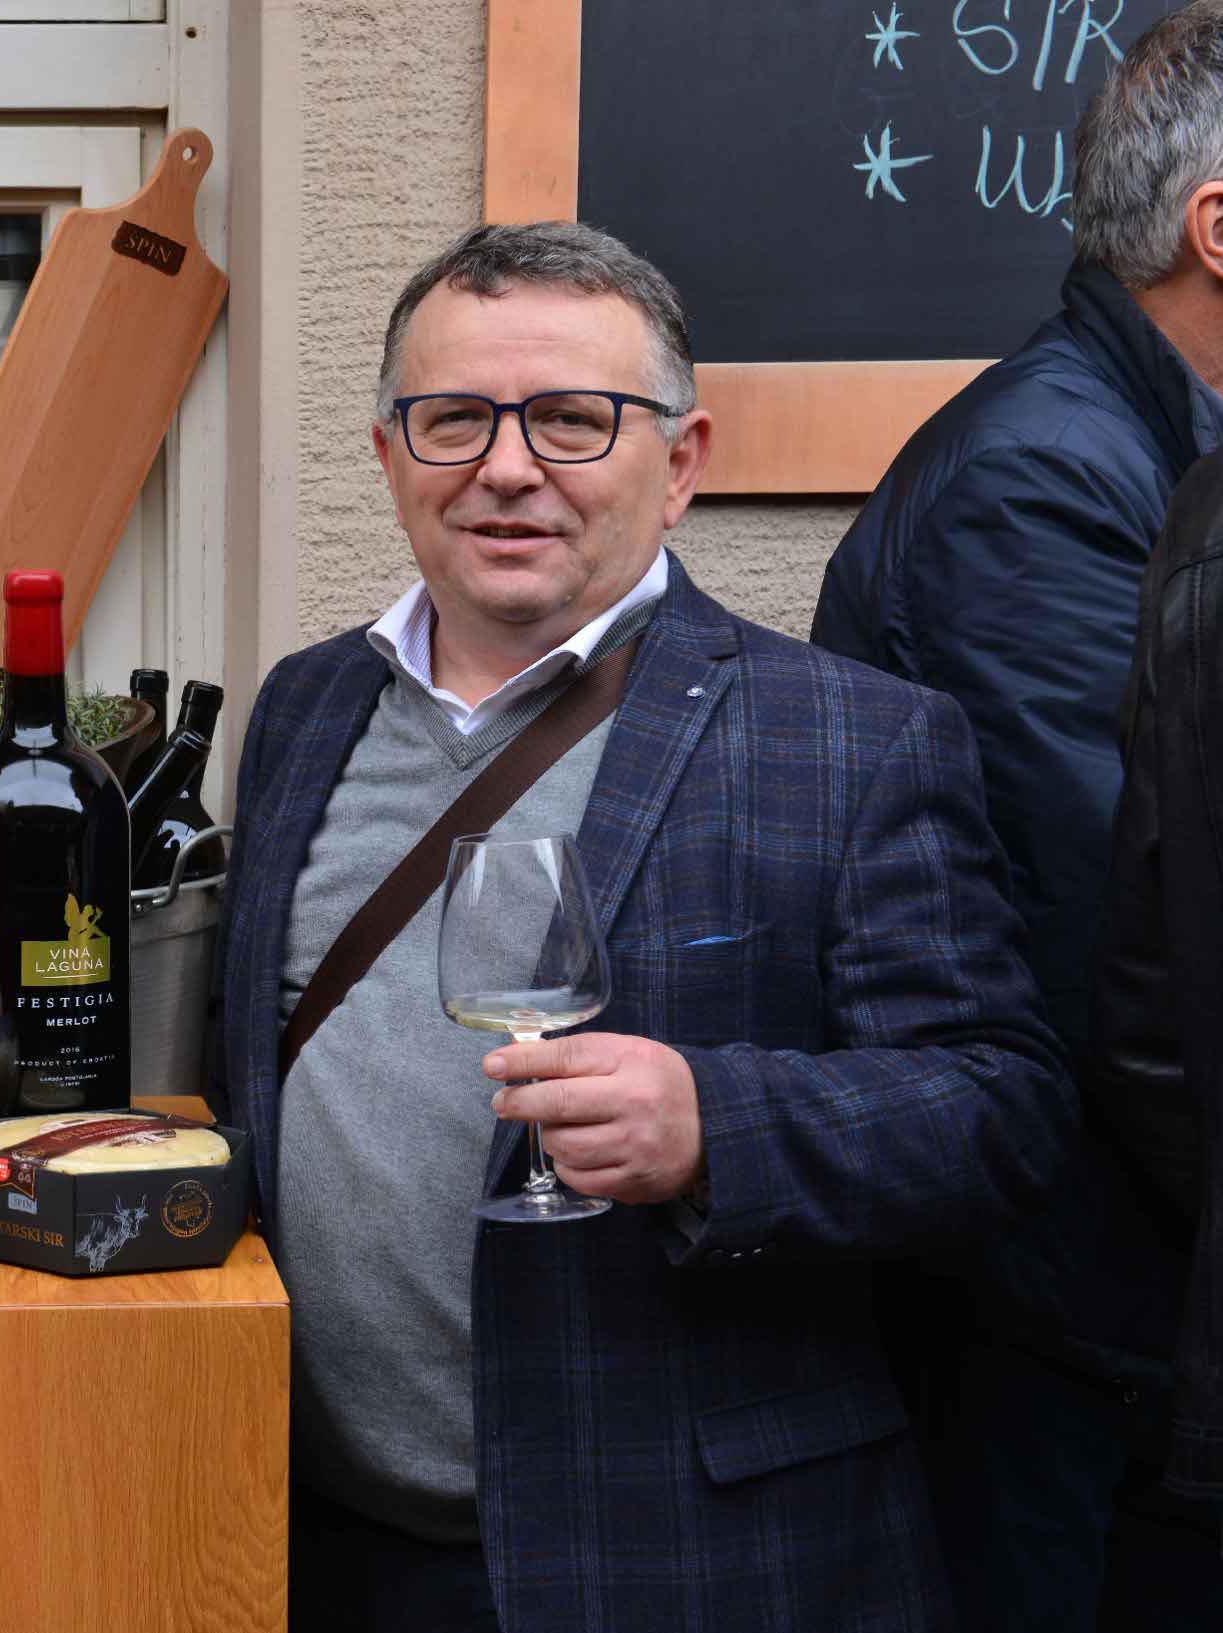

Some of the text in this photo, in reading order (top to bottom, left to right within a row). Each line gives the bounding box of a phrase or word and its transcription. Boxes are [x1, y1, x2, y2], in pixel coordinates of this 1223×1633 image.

[49, 947, 91, 960] VINA
[35, 957, 104, 973] LAGUNA
[17, 992, 114, 1009] FESTIGIA
[46, 1015, 97, 1027] MERLOT
